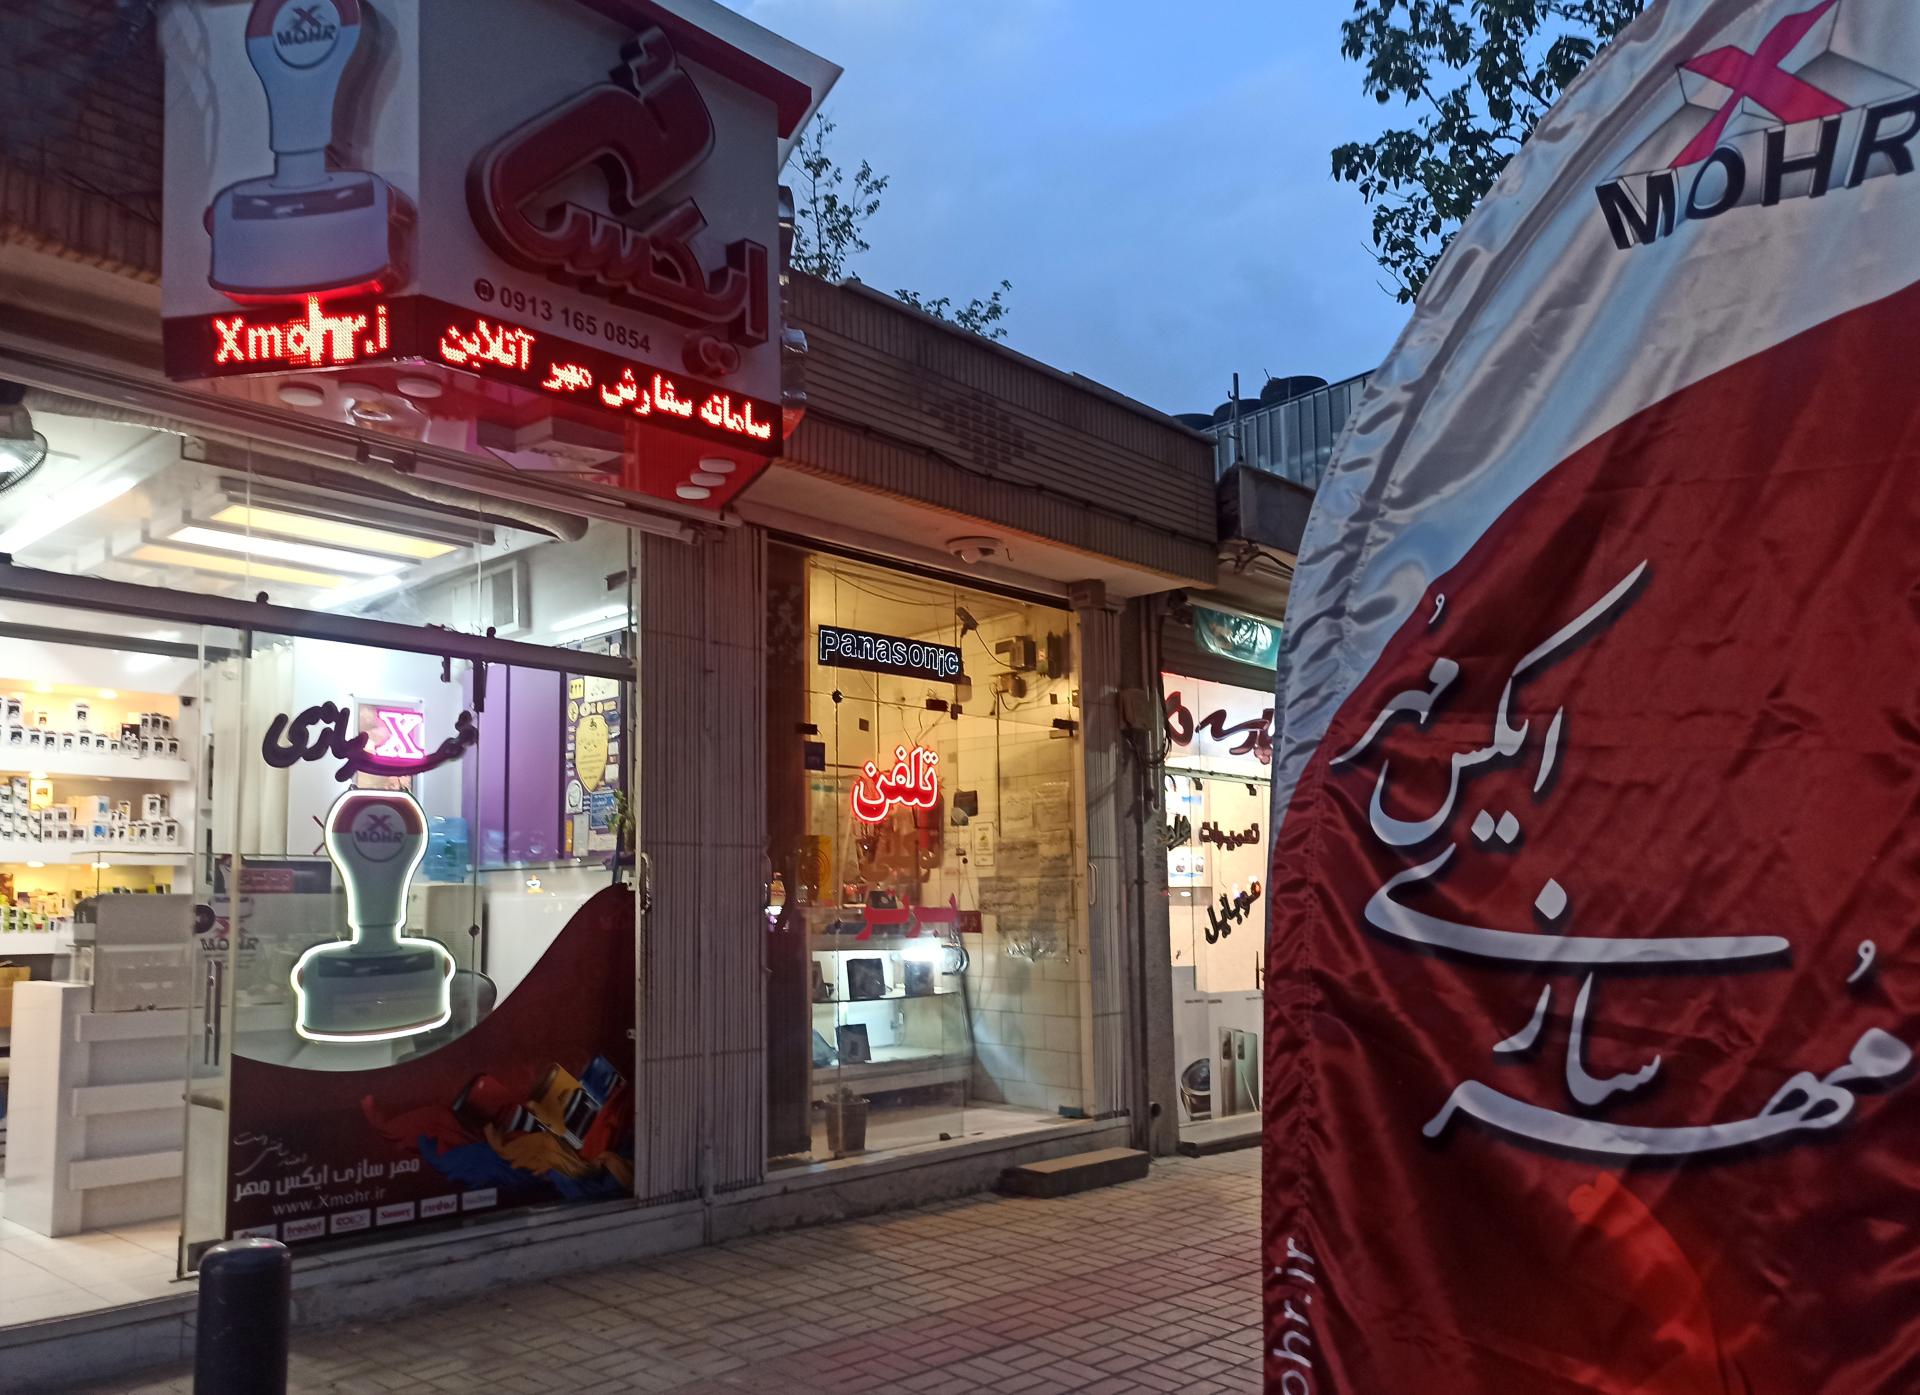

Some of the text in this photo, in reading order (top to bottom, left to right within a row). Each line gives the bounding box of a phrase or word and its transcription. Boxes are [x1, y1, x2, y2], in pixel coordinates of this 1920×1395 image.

[276, 24, 337, 47] MOHR
[1595, 94, 1920, 250] MOHR
[499, 286, 651, 353] 0913 165 0854
[440, 319, 772, 440] سامانه سفارش مهر آنلاین
[1368, 558, 1649, 846] ایکس
[376, 710, 425, 760] X
[853, 744, 940, 823] تلفن
[354, 830, 405, 844] MOHR
[1204, 880, 1261, 945] موبایل
[233, 1158, 420, 1202] مهر سازی ایکس مهر
[272, 1187, 386, 1216] www.Xmohr.ir
